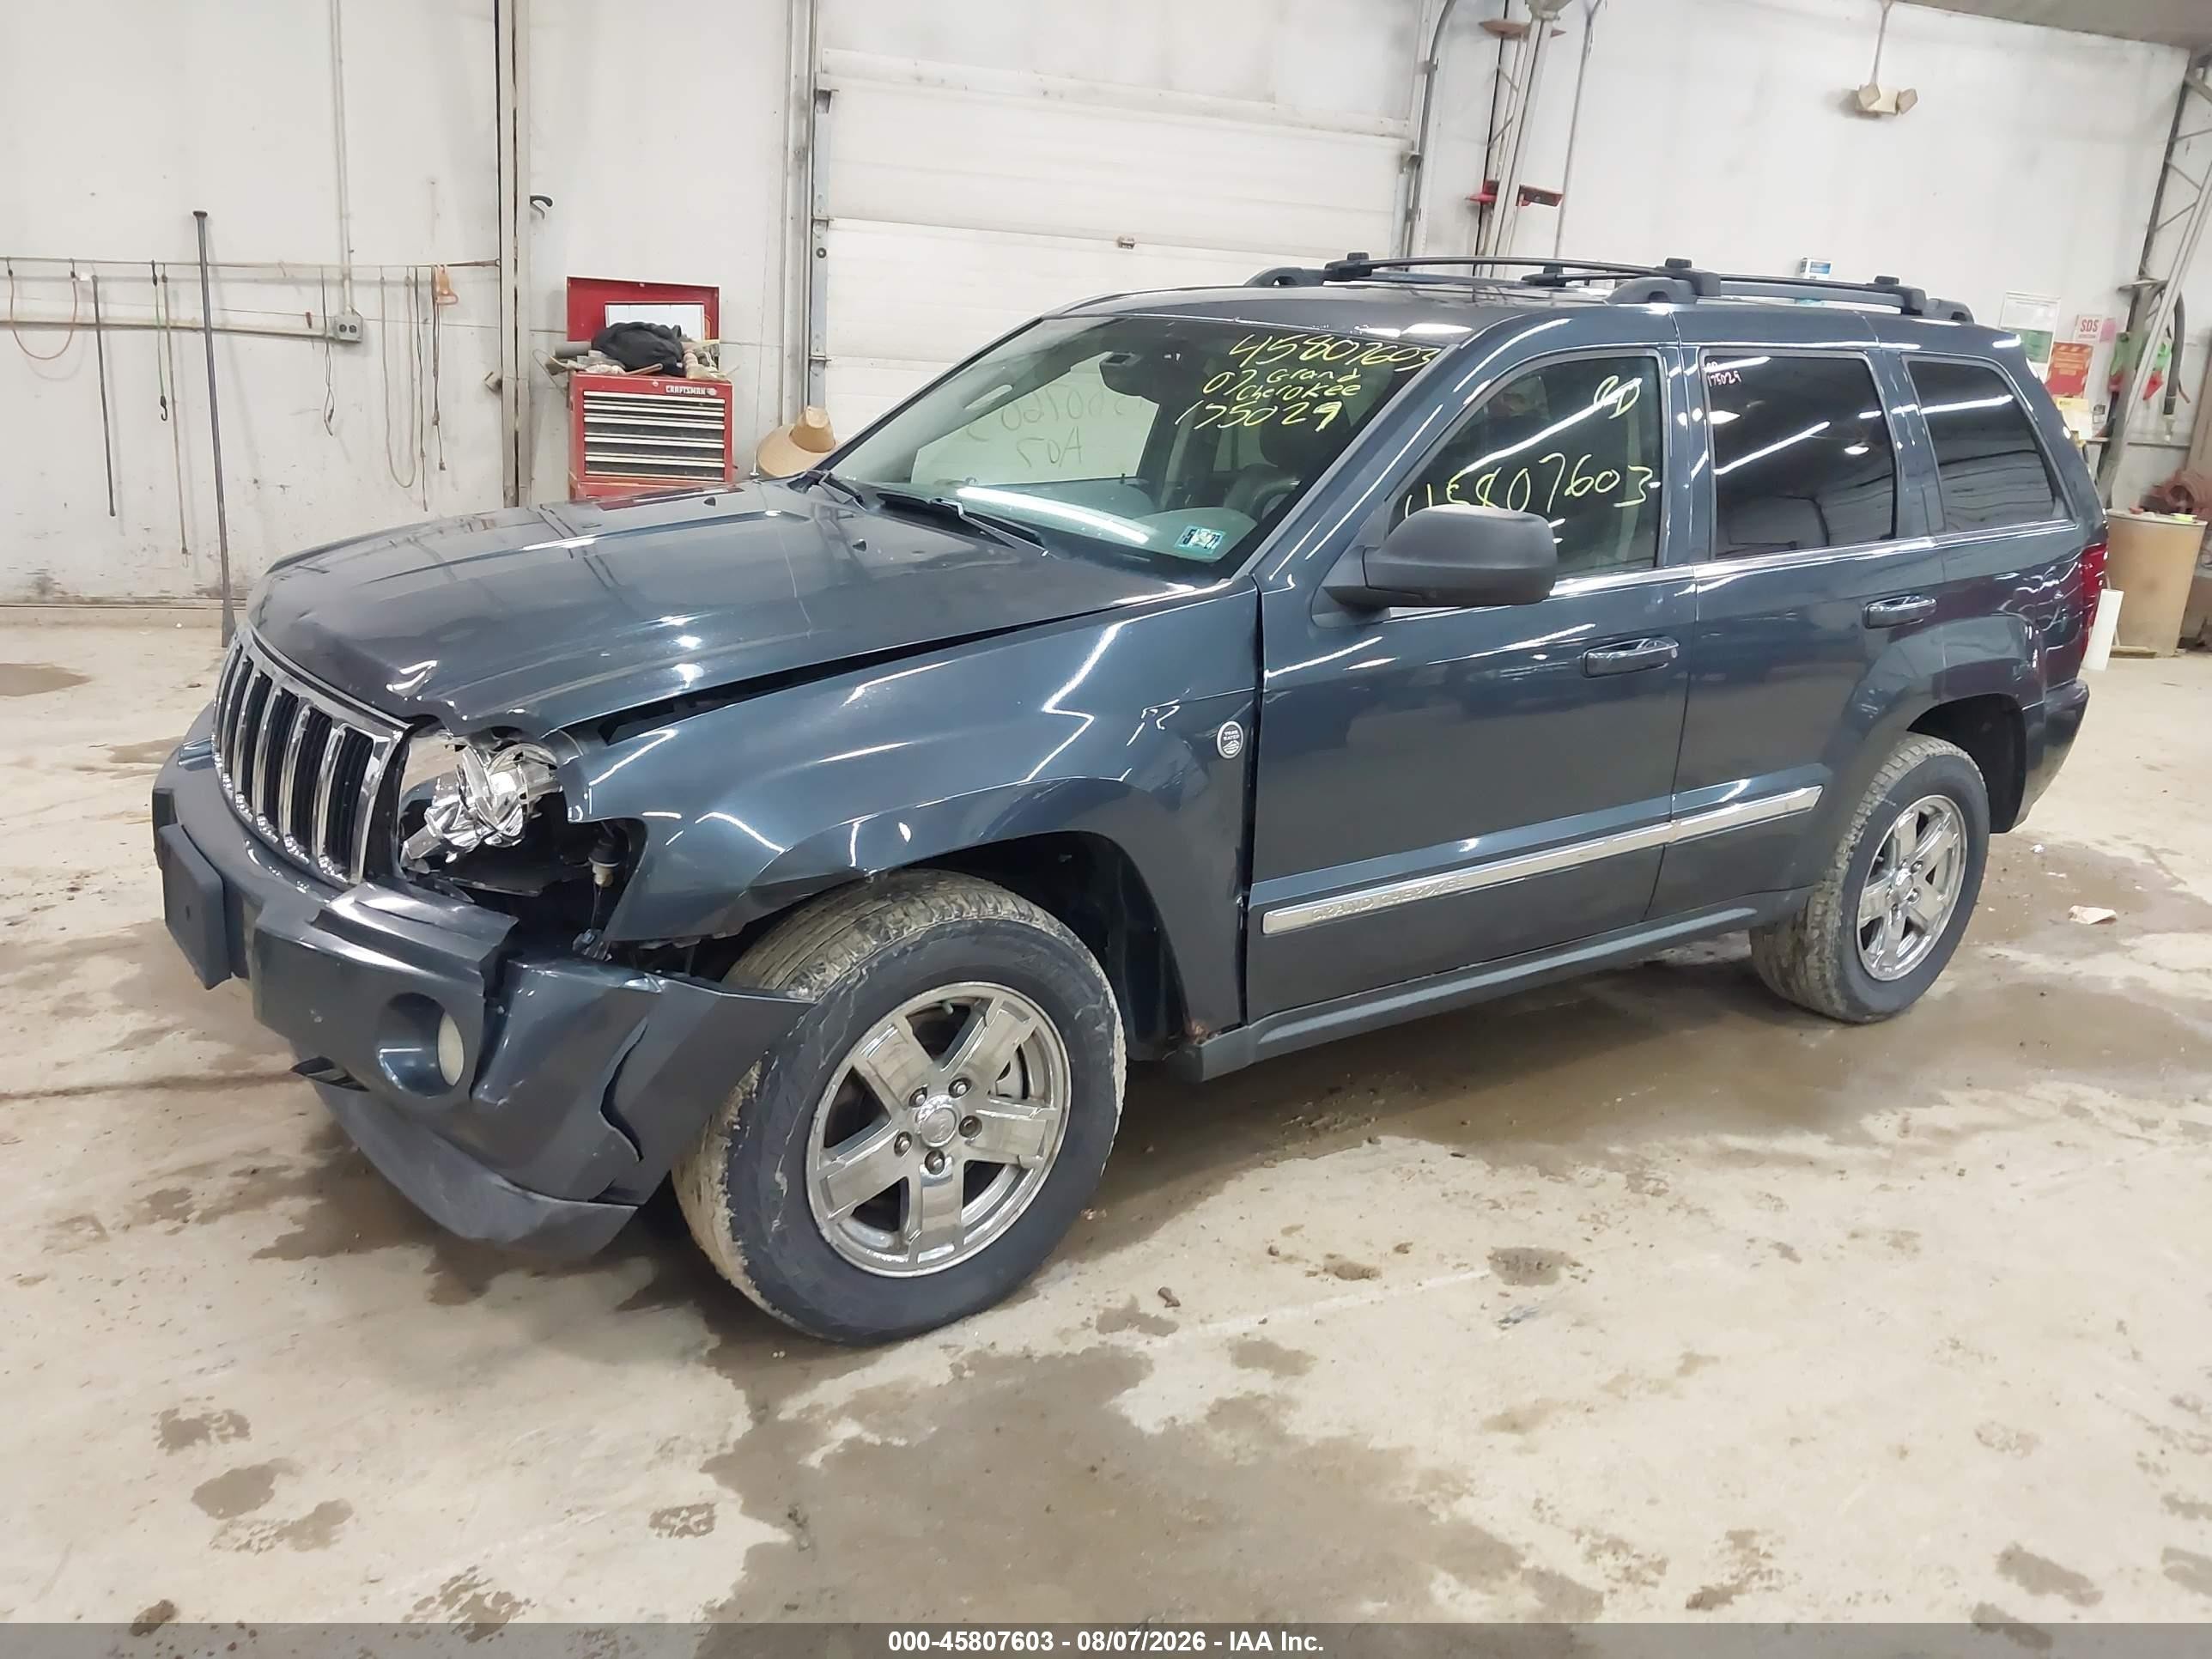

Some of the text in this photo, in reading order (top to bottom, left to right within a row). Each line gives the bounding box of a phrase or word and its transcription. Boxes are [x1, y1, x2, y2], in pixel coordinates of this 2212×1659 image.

[2081, 319, 2100, 332] SDS
[1229, 334, 1443, 372] 45807603
[1202, 368, 1361, 396] 07 Grand
[1236, 384, 1362, 401] Cherokee
